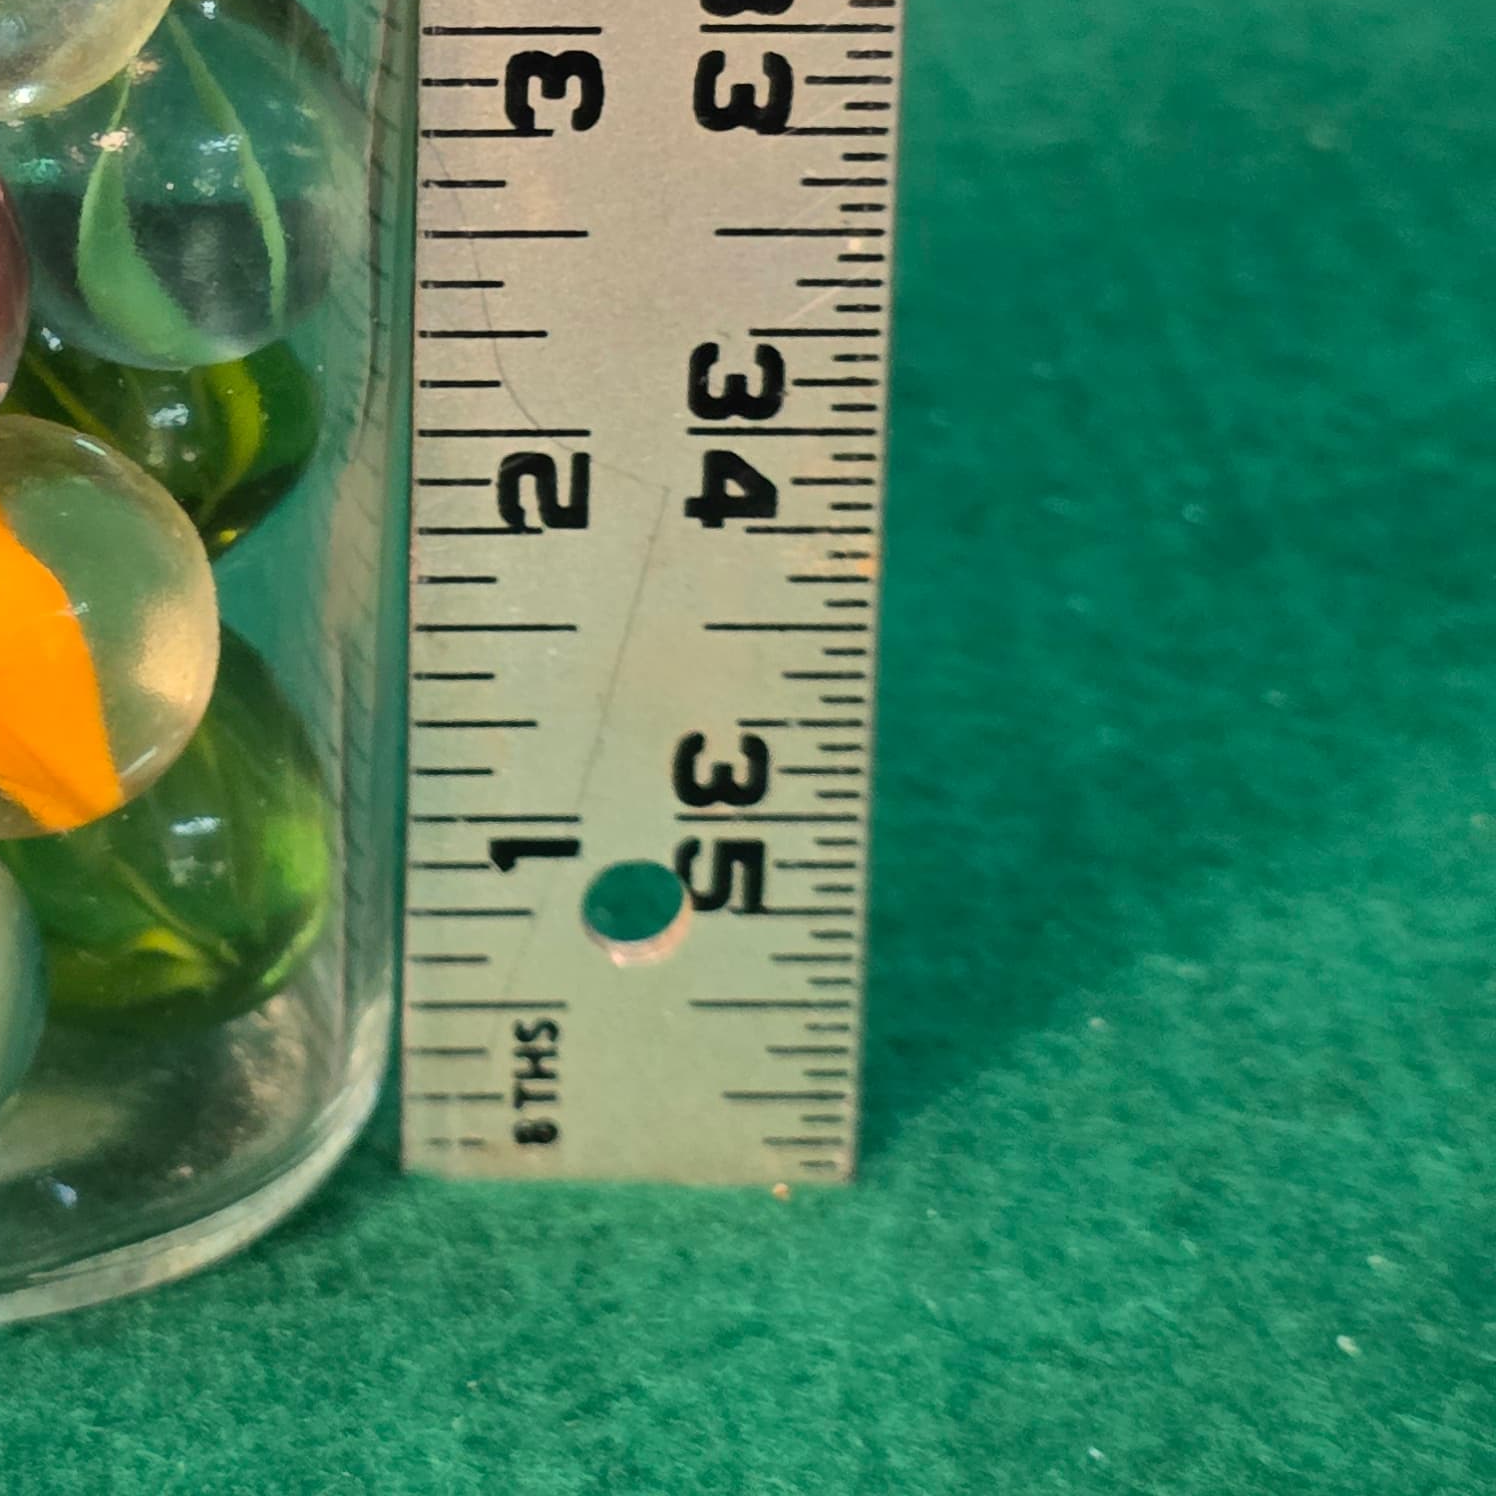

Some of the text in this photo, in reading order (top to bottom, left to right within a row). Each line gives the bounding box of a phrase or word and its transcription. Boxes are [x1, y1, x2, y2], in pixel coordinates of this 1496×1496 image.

[505, 50, 605, 132] 3
[496, 451, 591, 531] 2
[489, 838, 581, 873] 1
